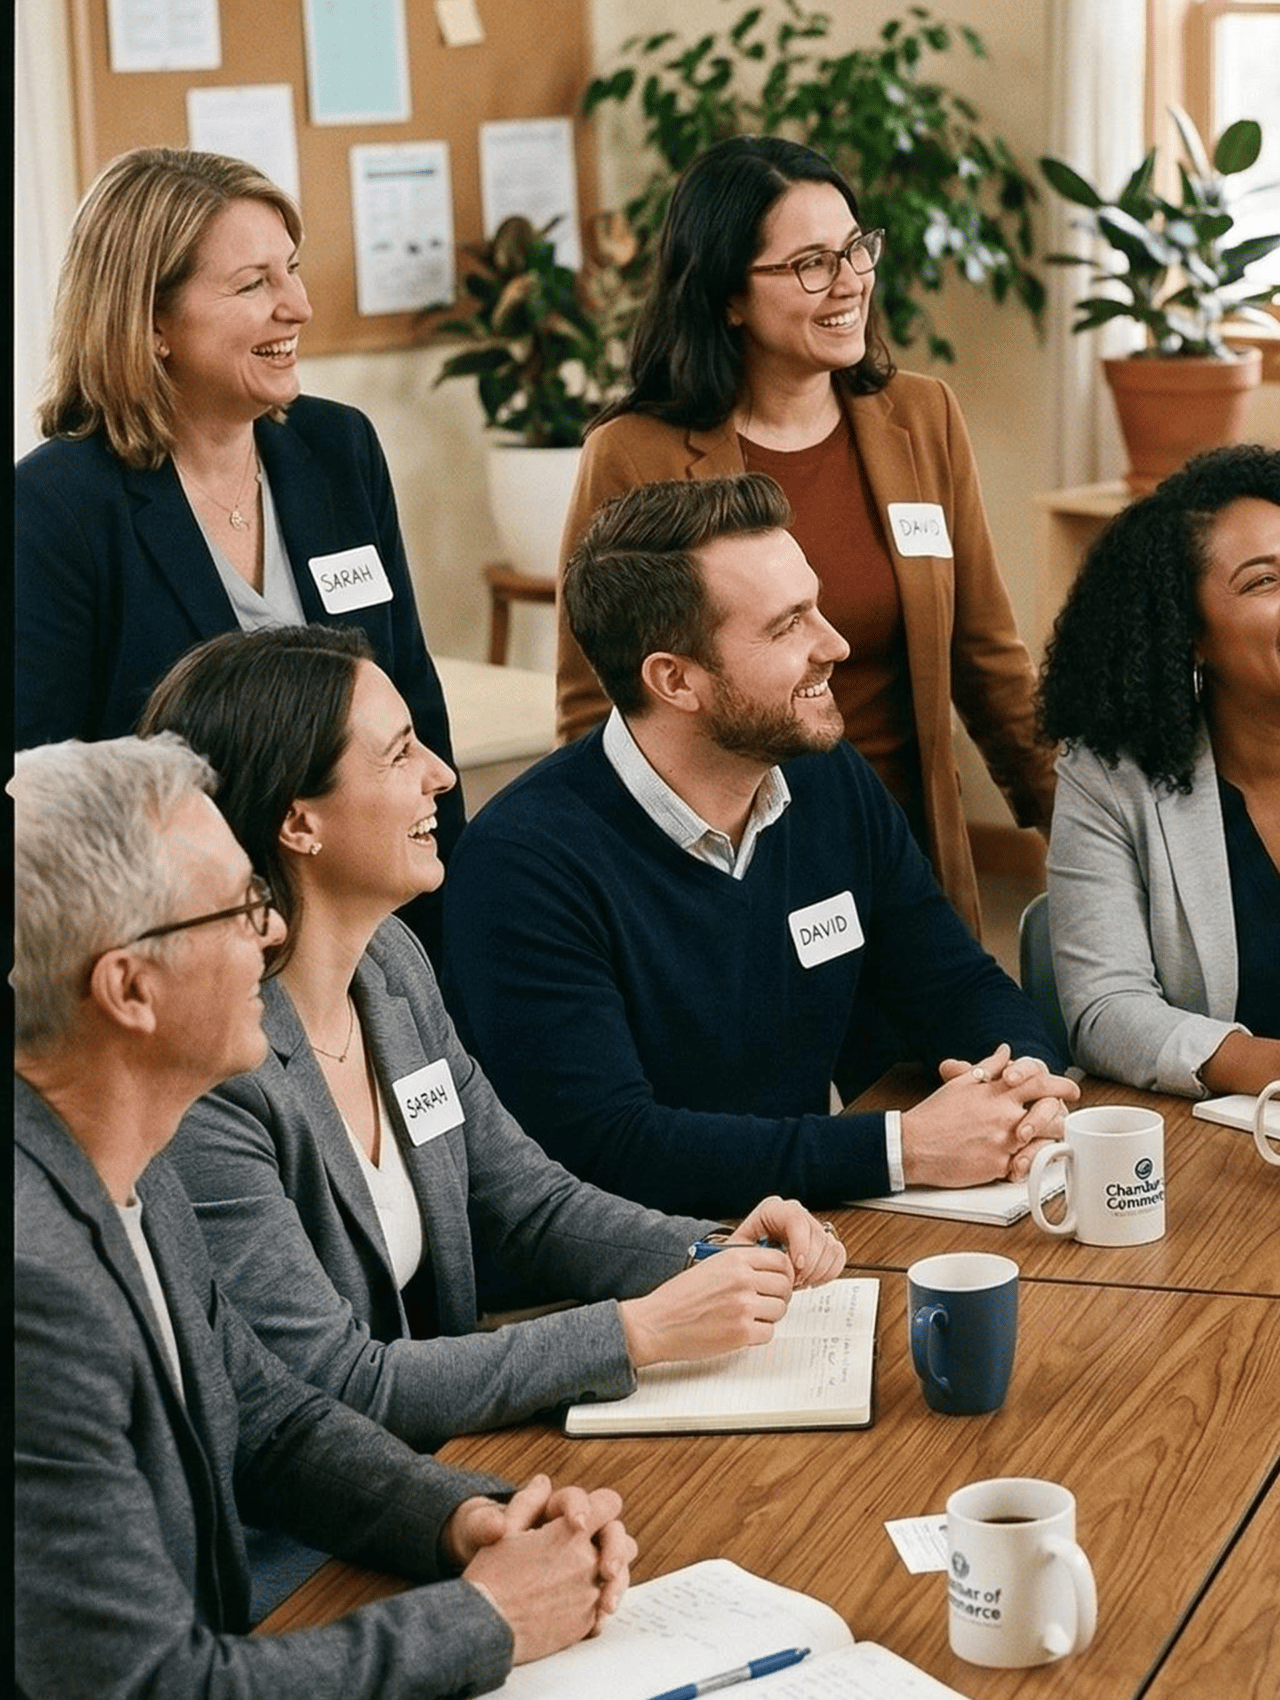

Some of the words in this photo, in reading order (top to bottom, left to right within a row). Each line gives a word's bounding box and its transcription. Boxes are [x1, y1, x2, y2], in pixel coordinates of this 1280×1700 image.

[320, 563, 374, 593] SARAH
[799, 915, 848, 946] DAVID
[406, 1084, 449, 1119] SARAH
